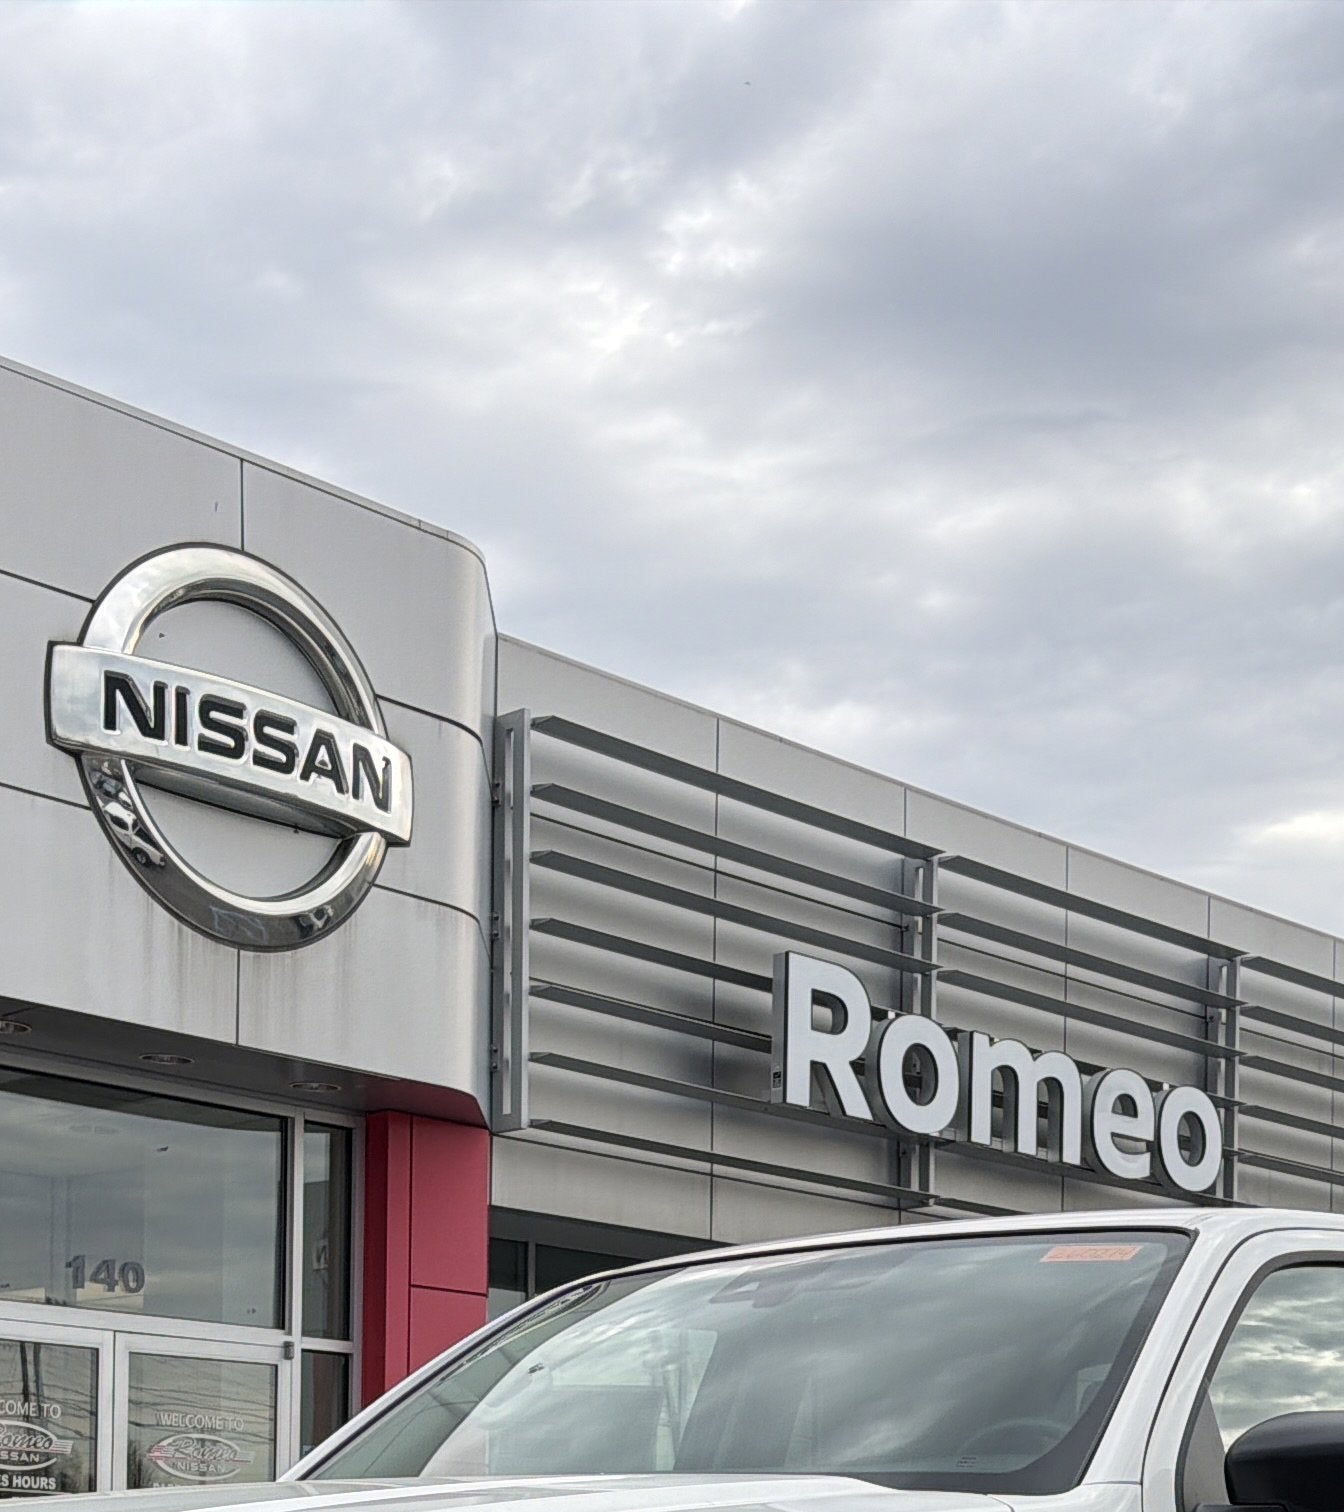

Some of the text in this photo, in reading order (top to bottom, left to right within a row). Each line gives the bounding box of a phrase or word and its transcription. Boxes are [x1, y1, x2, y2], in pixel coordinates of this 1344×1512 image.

[102, 670, 393, 814] NISSAN
[776, 951, 1223, 1192] Romeo
[66, 1254, 145, 1293] 140
[40, 1403, 61, 1419] TO
[160, 1413, 244, 1431] WELCOME TO
[176, 1461, 225, 1473] NISSAN
[12, 1475, 56, 1490] HOURS
